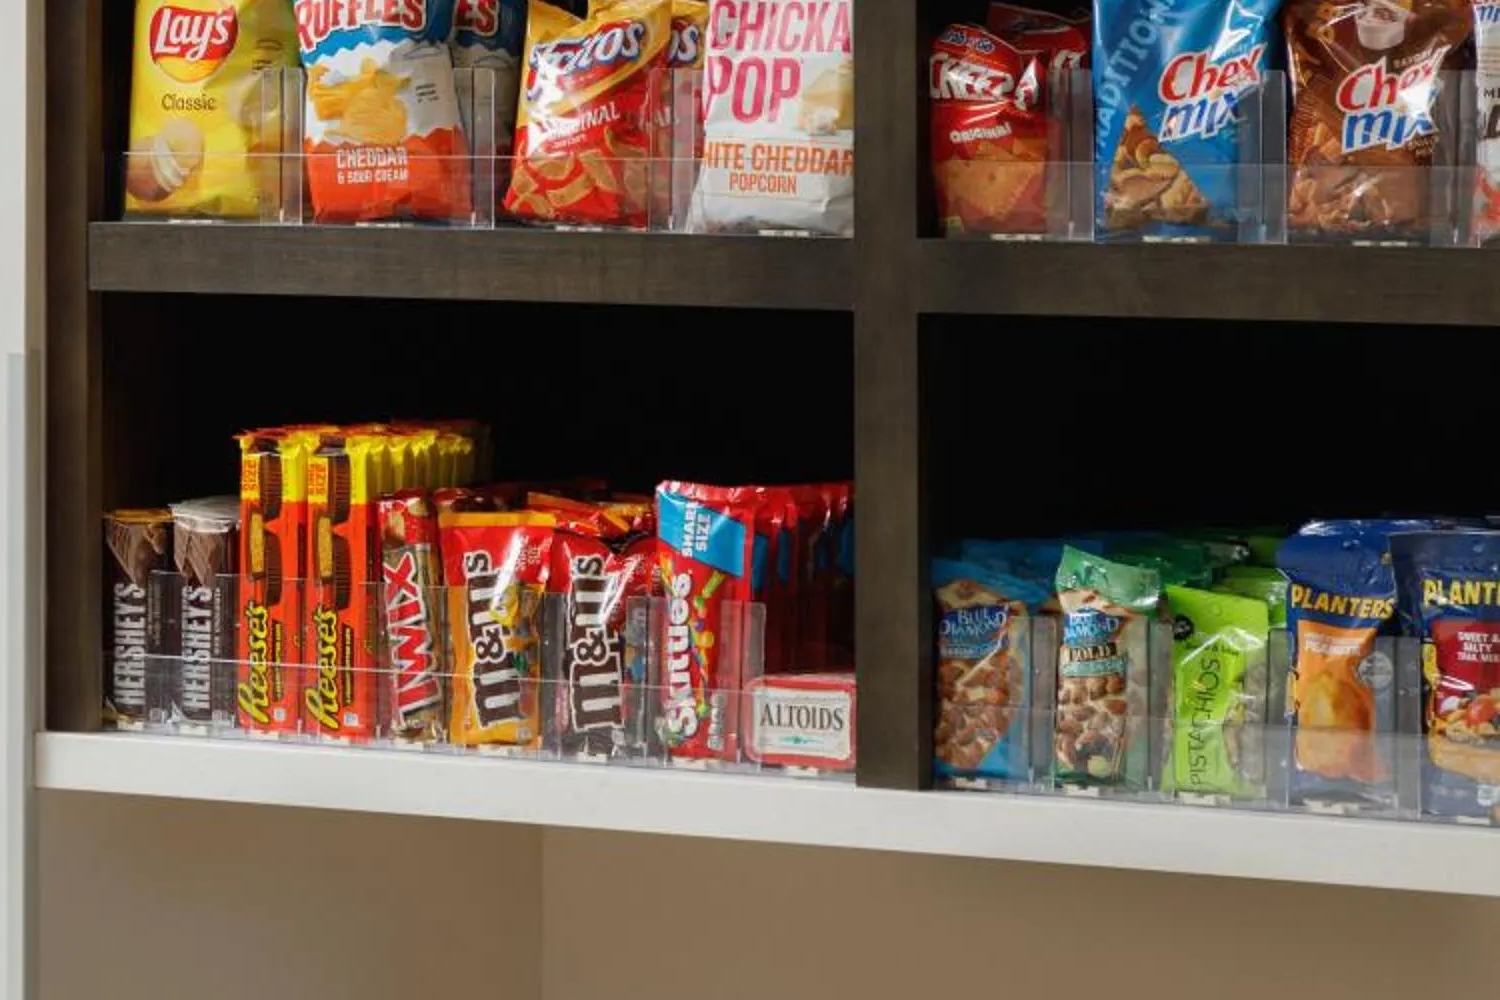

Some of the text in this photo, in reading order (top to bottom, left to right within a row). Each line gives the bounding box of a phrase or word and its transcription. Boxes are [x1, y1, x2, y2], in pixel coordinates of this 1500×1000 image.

[154, 5, 232, 61] Lay's
[705, 54, 802, 124] POP
[1160, 45, 1266, 104] Chex
[160, 93, 217, 112] Classic
[336, 146, 409, 169] CHEDDAR
[703, 141, 746, 171] HITE
[728, 171, 798, 195] POPCORN
[1290, 582, 1396, 620] PLANTERS
[1421, 577, 1500, 608] PLANT
[113, 581, 148, 706] HERSHEY'S
[180, 584, 213, 711] HERSHEY'S
[382, 551, 443, 714] TWIX
[759, 702, 845, 731] ALTOIDS
[1187, 656, 1222, 786] PISTACHIOS
